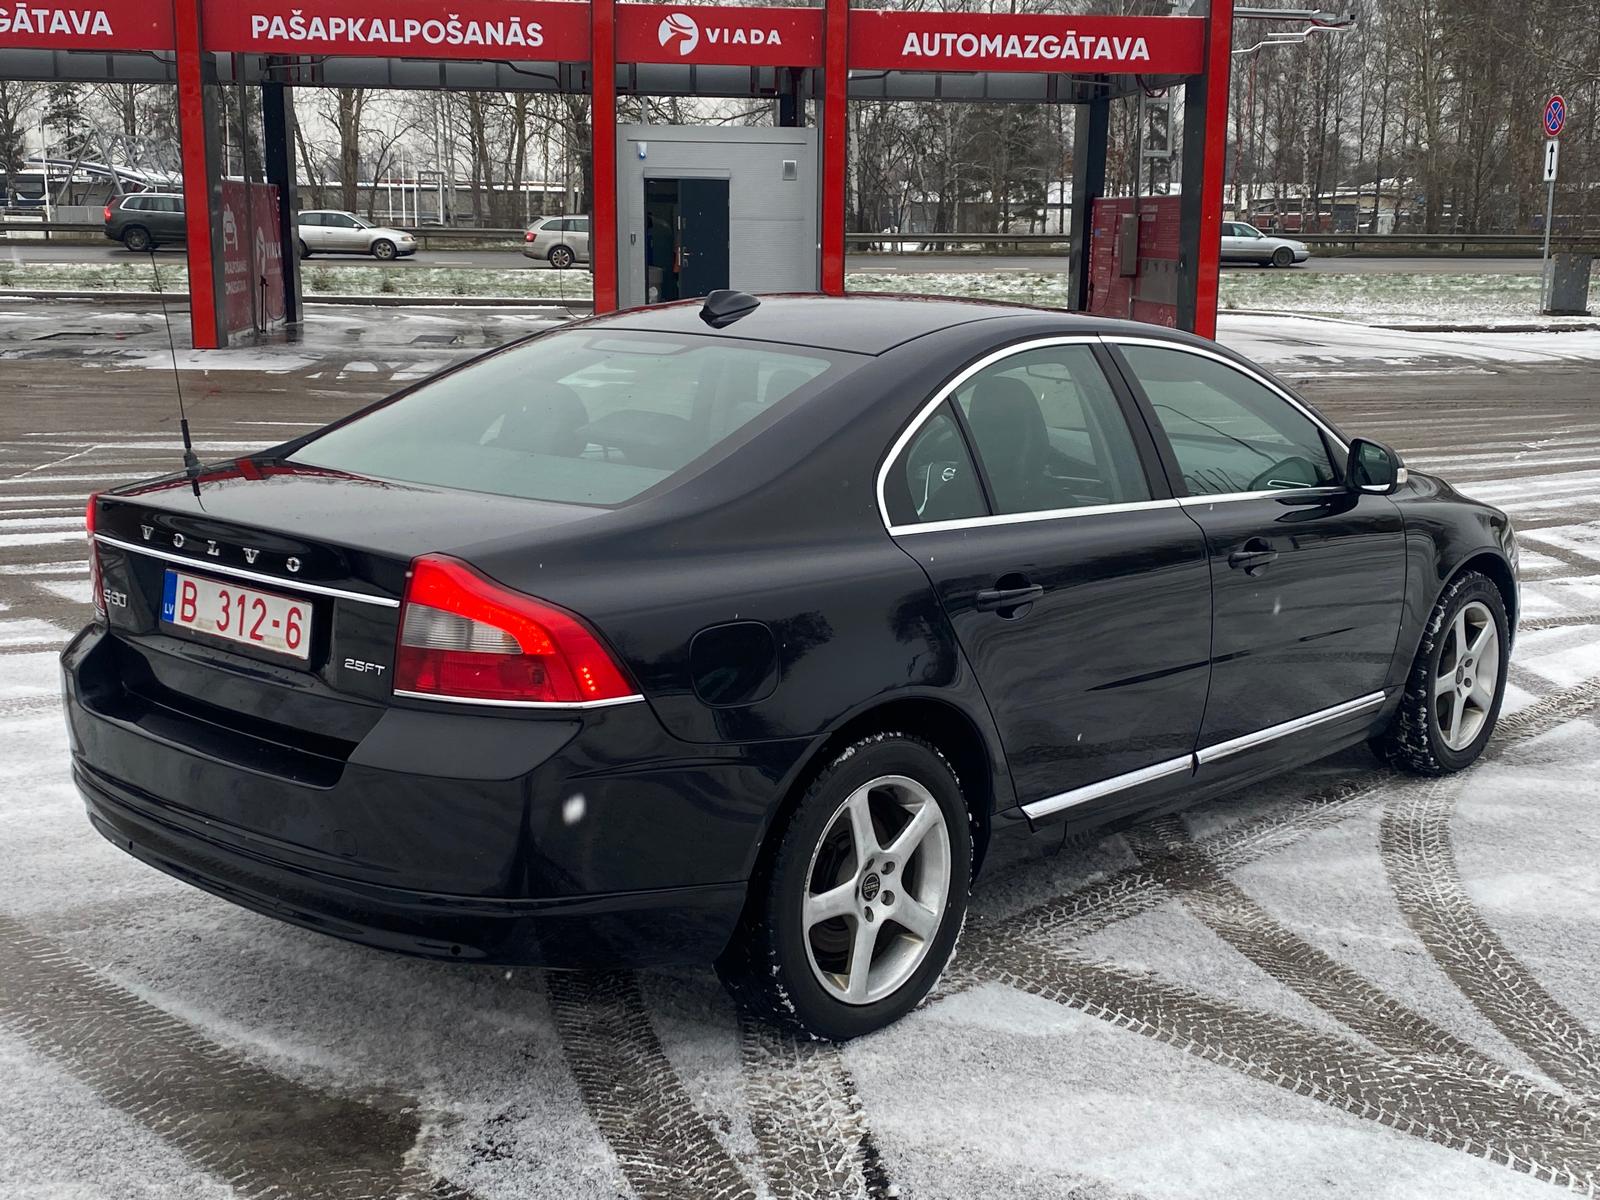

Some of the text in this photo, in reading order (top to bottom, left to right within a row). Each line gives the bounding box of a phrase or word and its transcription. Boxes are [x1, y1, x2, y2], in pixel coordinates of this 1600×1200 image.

[251, 9, 544, 48] PAŠAPKALPOŠANĀS
[705, 27, 782, 46] VIADA
[901, 30, 1150, 61] AUTOMAZGĀTAVA
[141, 525, 302, 571] VOLVO
[164, 602, 175, 615] LV
[180, 581, 303, 650] B 312-6
